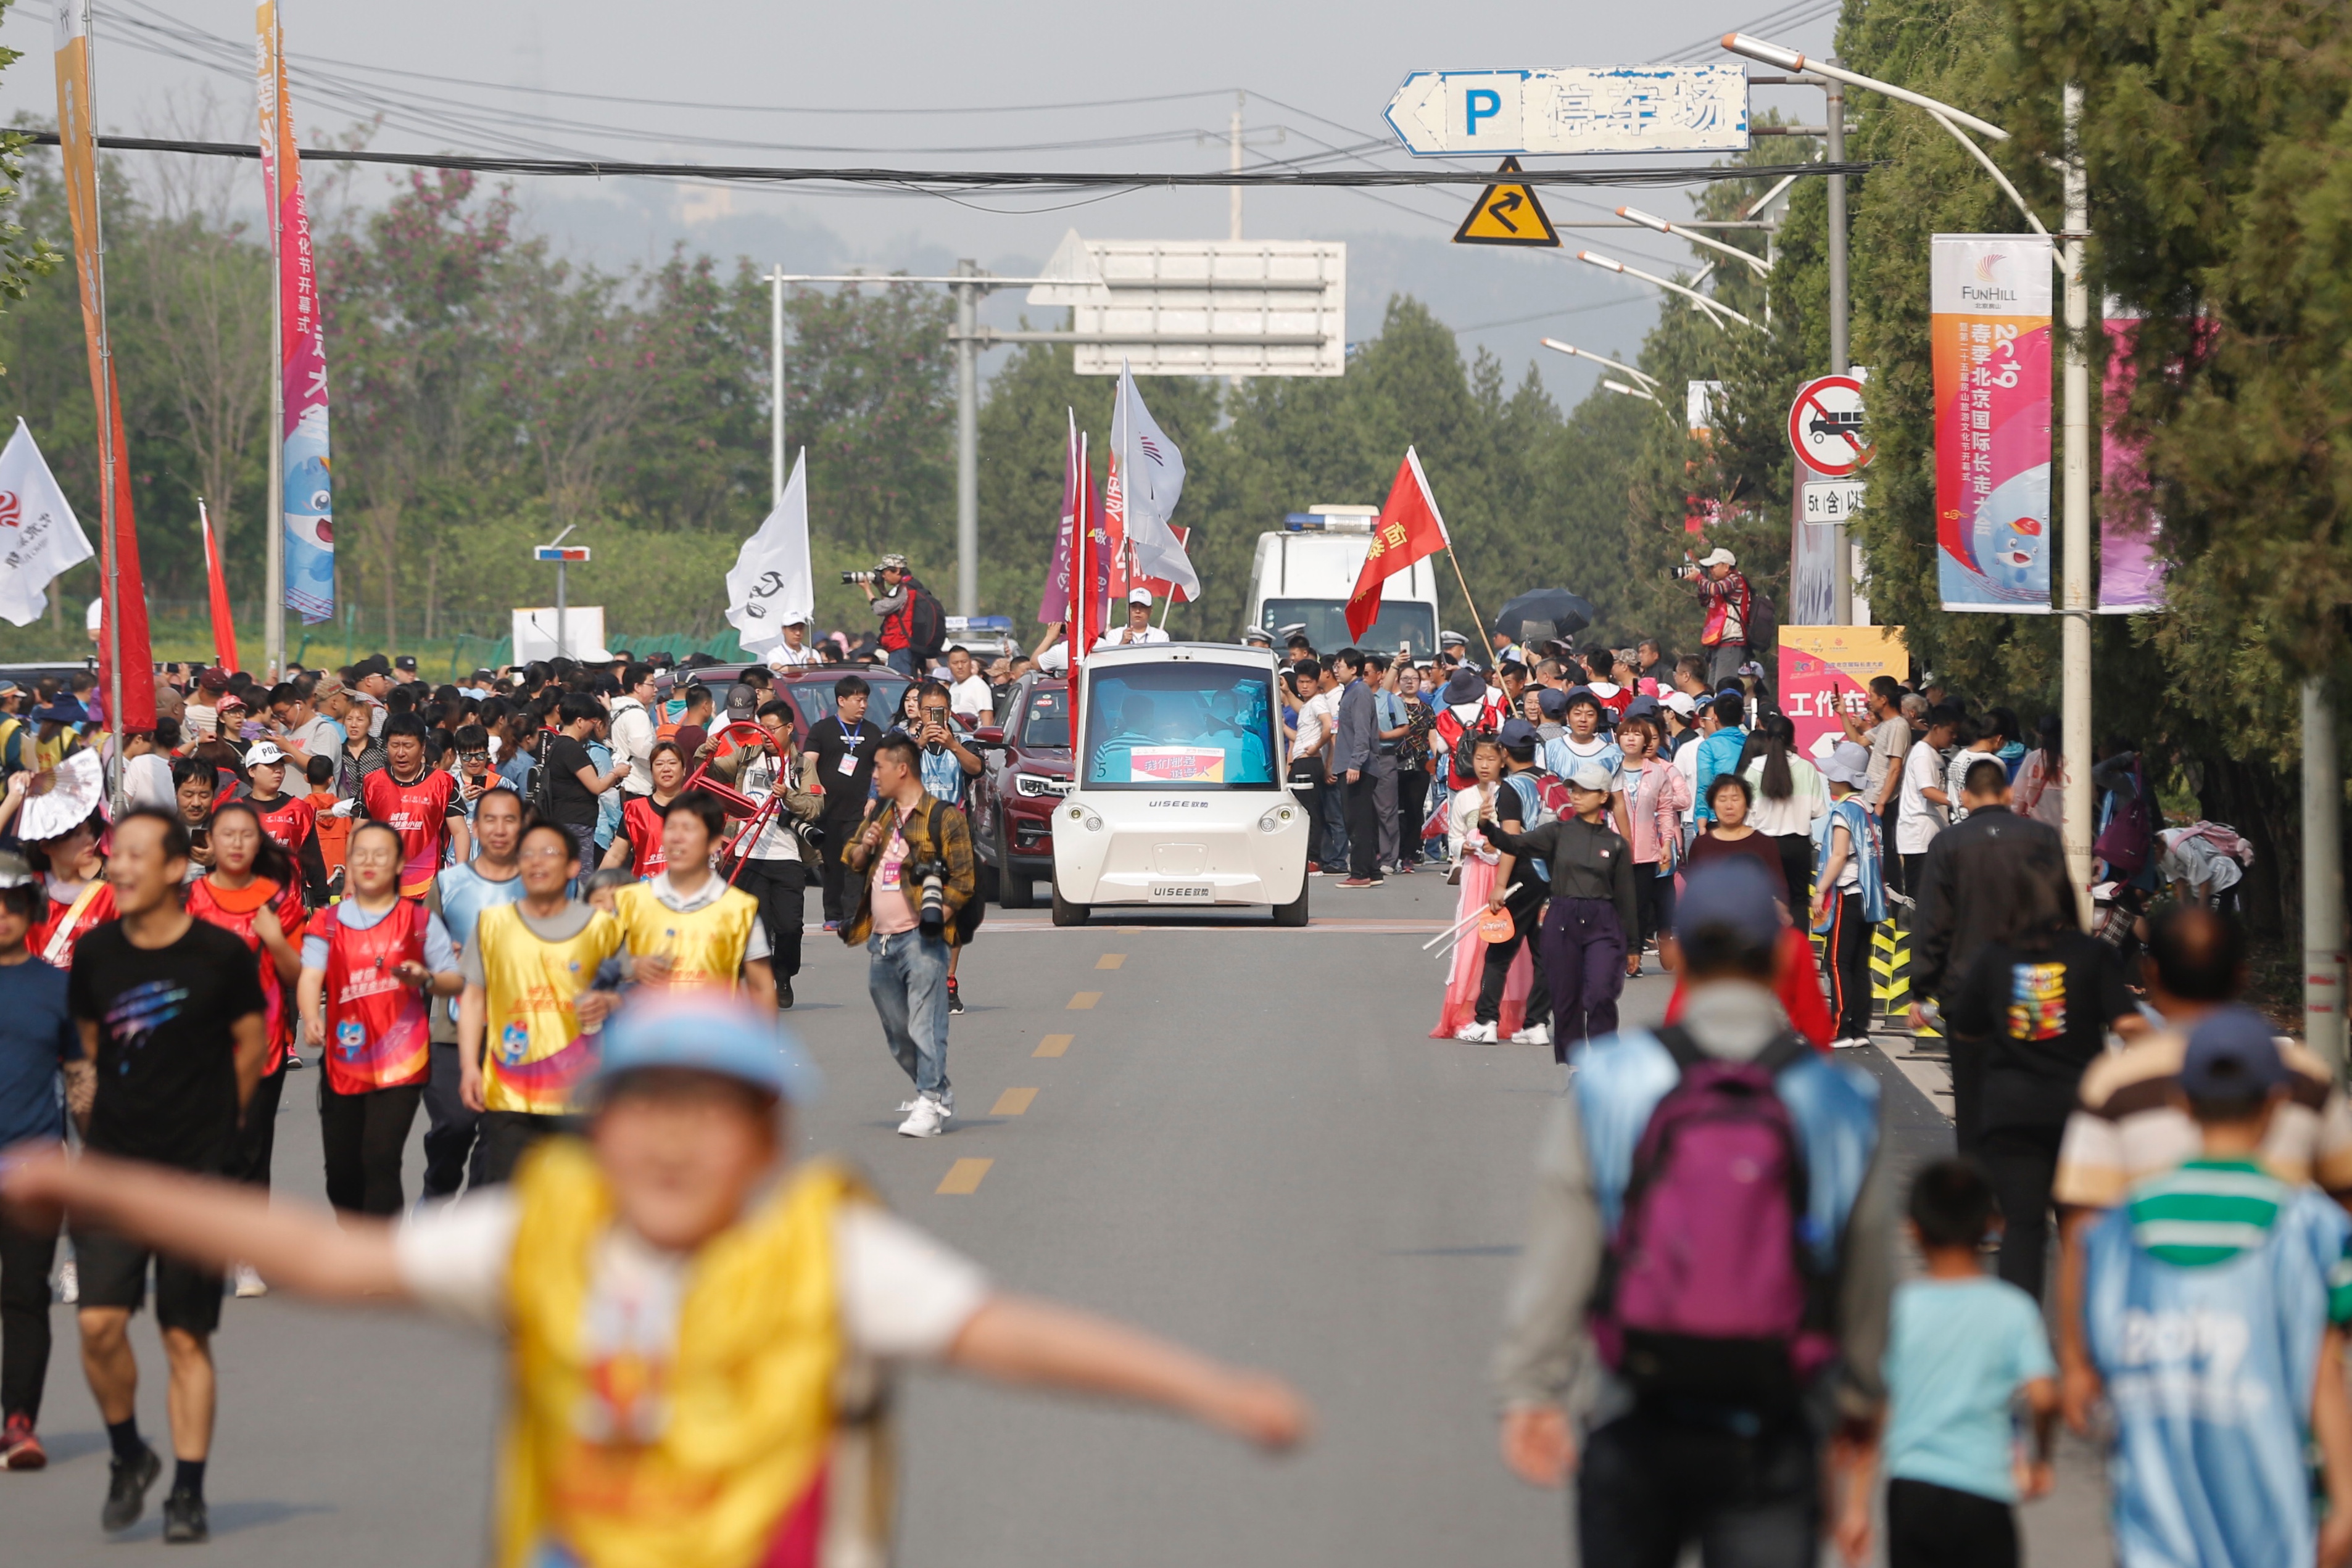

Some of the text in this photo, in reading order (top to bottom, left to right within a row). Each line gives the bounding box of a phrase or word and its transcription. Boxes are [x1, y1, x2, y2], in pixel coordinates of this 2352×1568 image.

[1466, 80, 1725, 138] P 停车场
[1971, 323, 1992, 536] 春季北京国际长走大会
[1097, 762, 1106, 777] 5
